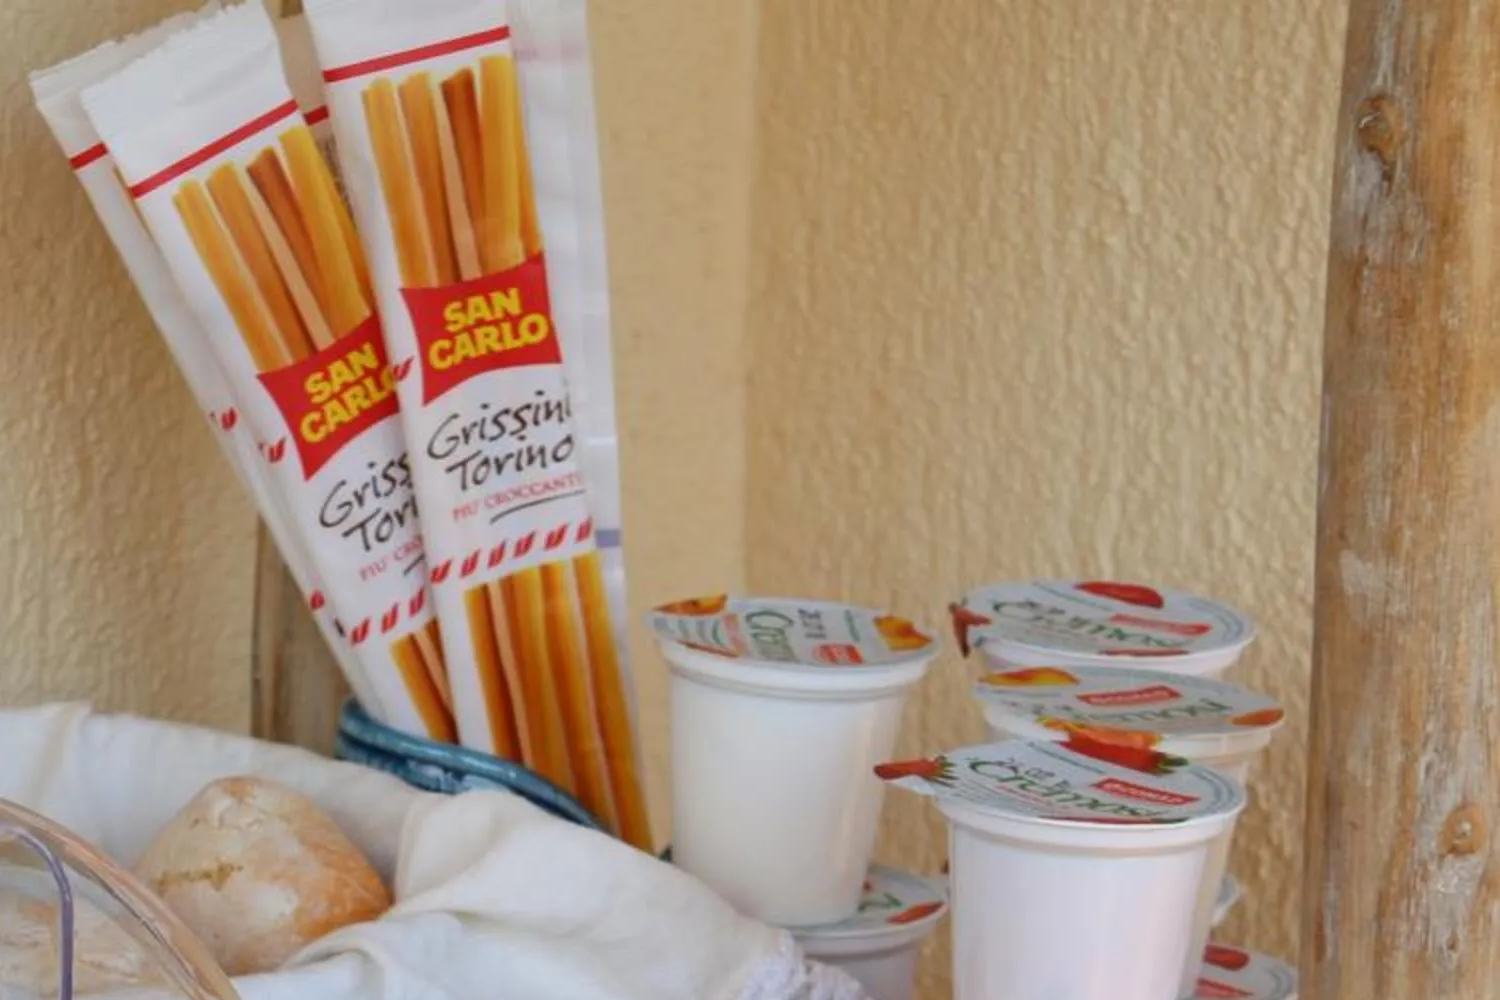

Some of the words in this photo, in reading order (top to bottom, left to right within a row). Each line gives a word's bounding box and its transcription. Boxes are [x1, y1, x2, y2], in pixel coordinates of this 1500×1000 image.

[443, 287, 522, 333] SAN
[428, 312, 550, 370] CARLO
[303, 342, 379, 404] SAN
[444, 434, 575, 492] Torino
